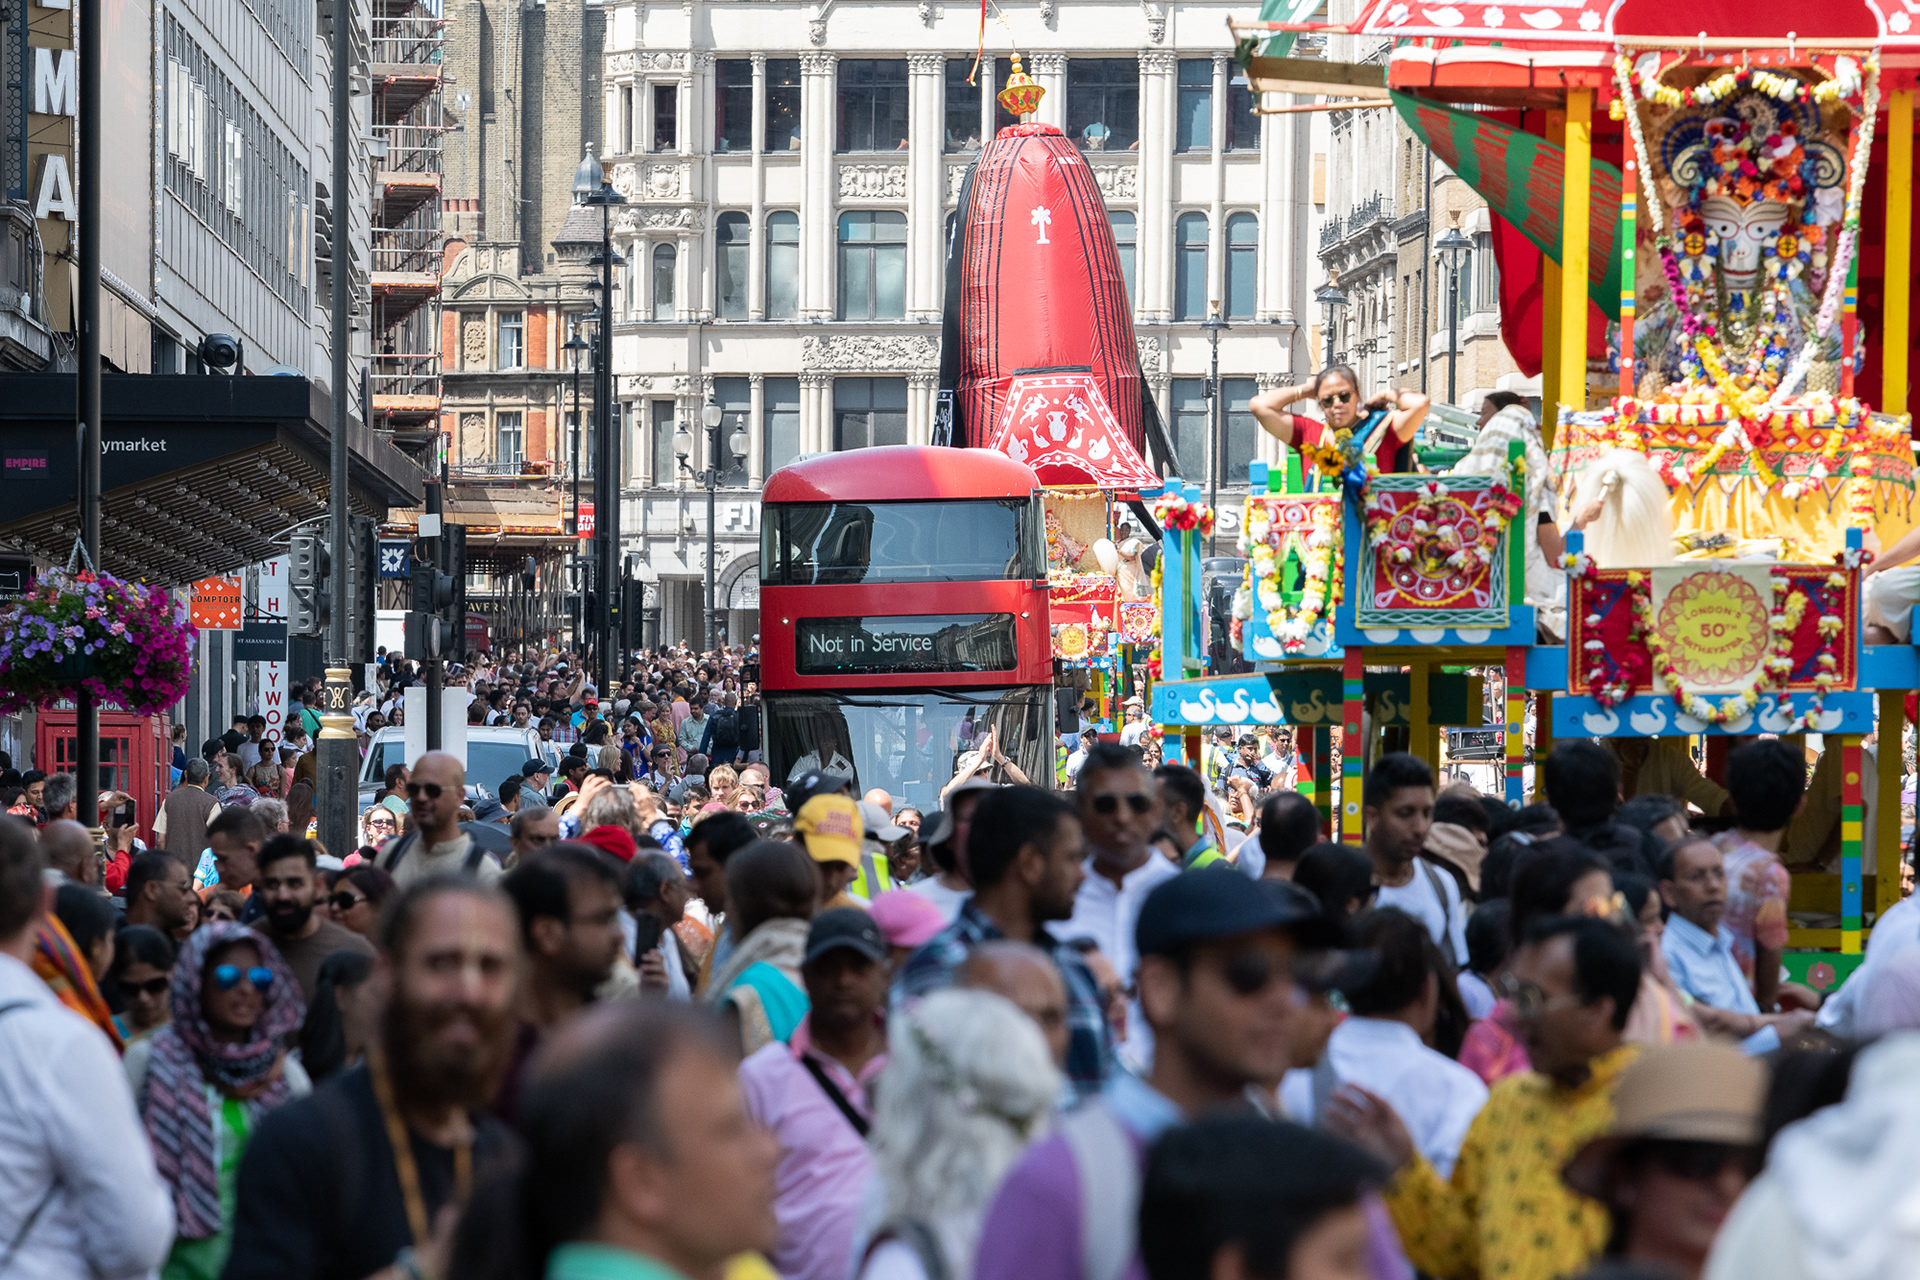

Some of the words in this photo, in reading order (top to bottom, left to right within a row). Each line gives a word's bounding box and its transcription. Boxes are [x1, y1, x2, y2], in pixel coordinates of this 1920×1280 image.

[30, 0, 76, 221] MA
[101, 437, 167, 455] ymarket
[5, 458, 47, 468] EMPIRE
[579, 514, 595, 523] FIV
[810, 633, 844, 653] Not
[851, 634, 865, 652] in
[872, 632, 932, 652] Service
